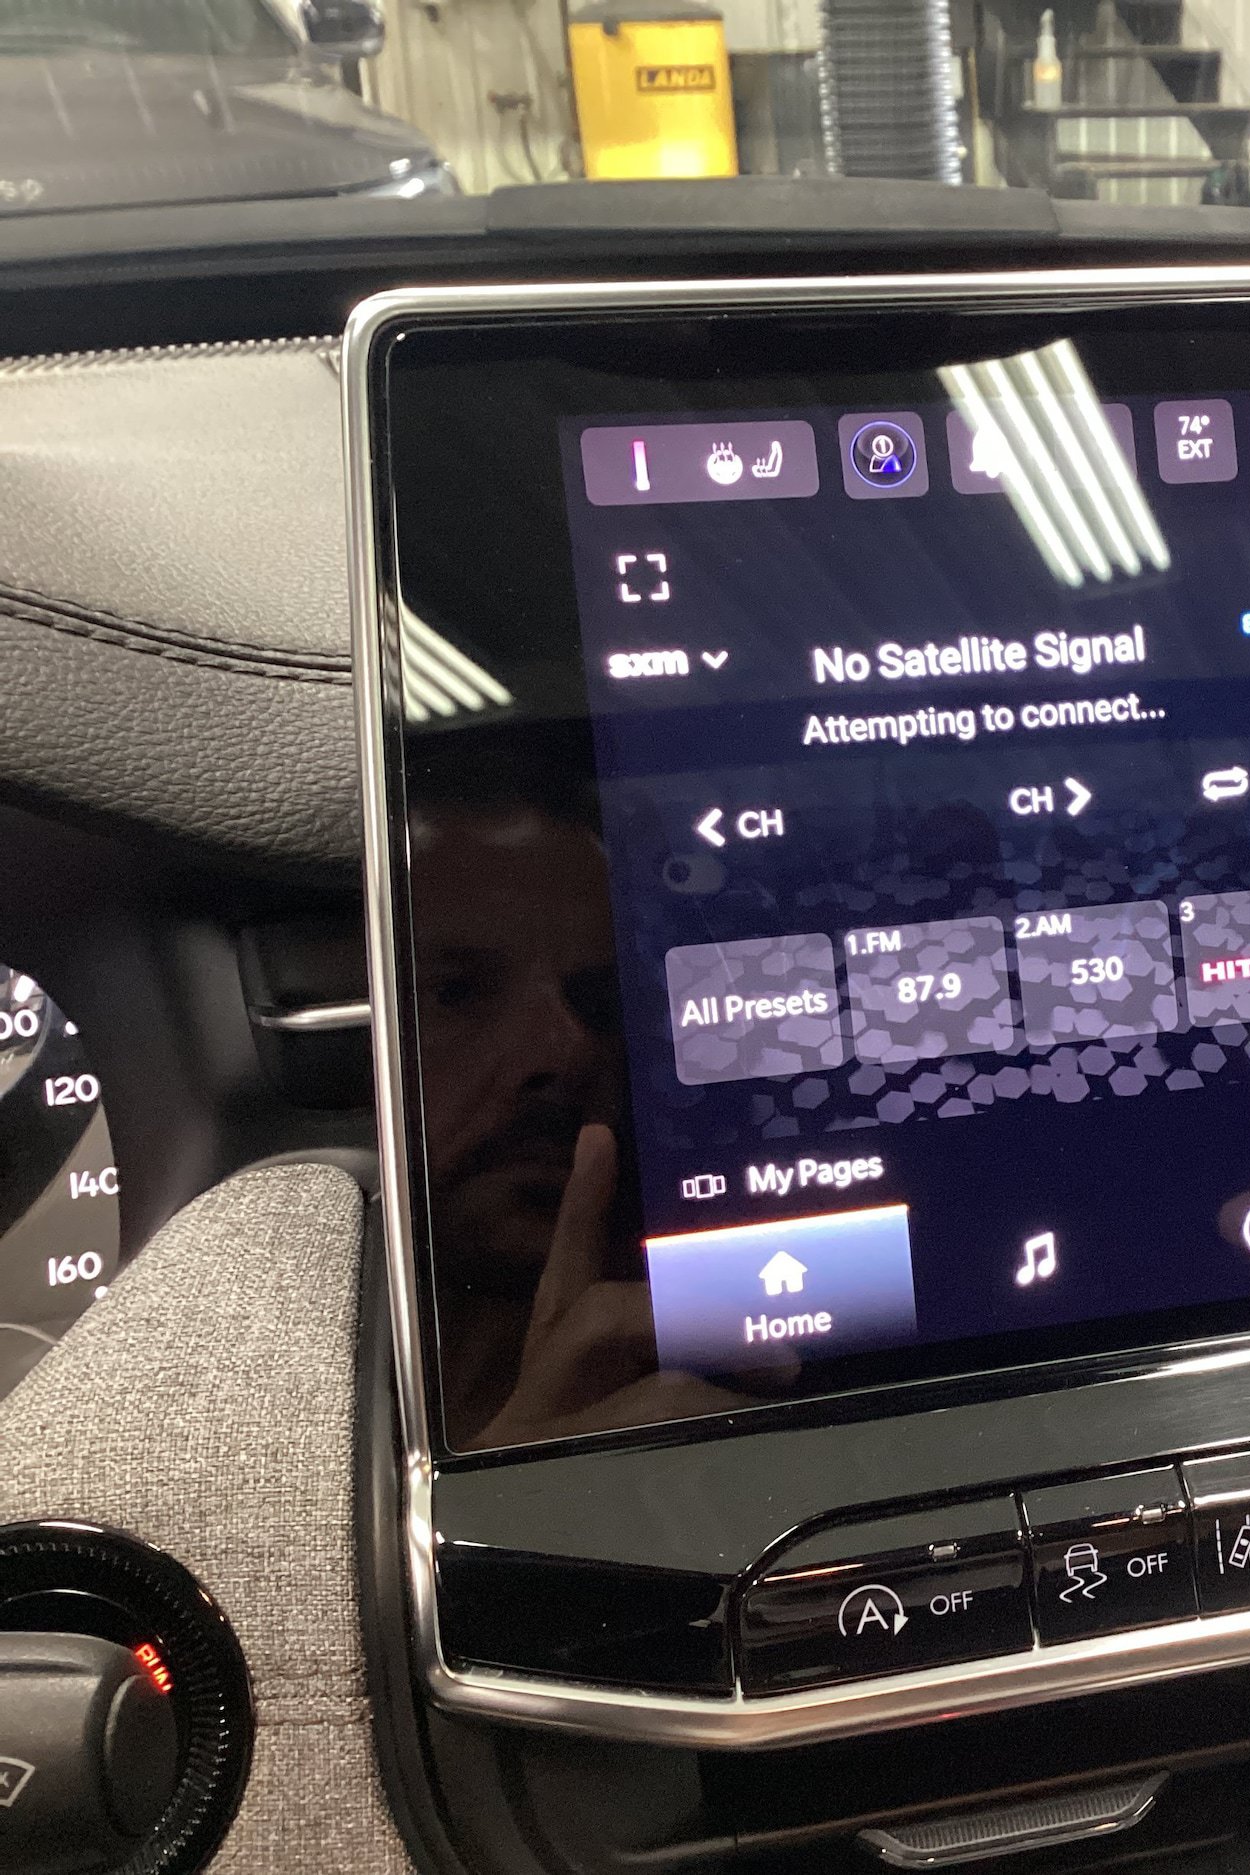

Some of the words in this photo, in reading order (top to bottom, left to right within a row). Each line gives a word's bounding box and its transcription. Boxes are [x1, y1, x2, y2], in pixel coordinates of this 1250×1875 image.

[1177, 438, 1213, 460] EXT
[813, 647, 870, 683] No
[878, 636, 1027, 679] Satellite
[1034, 625, 1145, 674] Signal
[803, 706, 976, 745] Attempting
[981, 704, 1014, 731] to
[1021, 693, 1166, 728] connect...
[1010, 786, 1054, 815] CH
[738, 809, 784, 838] CH
[1015, 913, 1072, 939] 2.AM
[1180, 901, 1195, 922] 3
[847, 930, 902, 956] 1.FM
[1071, 955, 1124, 985] 530
[897, 972, 962, 1004] 87.9
[681, 996, 719, 1027] All
[725, 989, 828, 1022] Presets
[45, 1074, 99, 1106] 120
[748, 1163, 794, 1195] My
[798, 1156, 884, 1188] Pages
[48, 1251, 102, 1287] 160
[745, 1311, 832, 1343] Home
[1126, 1552, 1169, 1578] OFF
[929, 1590, 973, 1616] OFF
